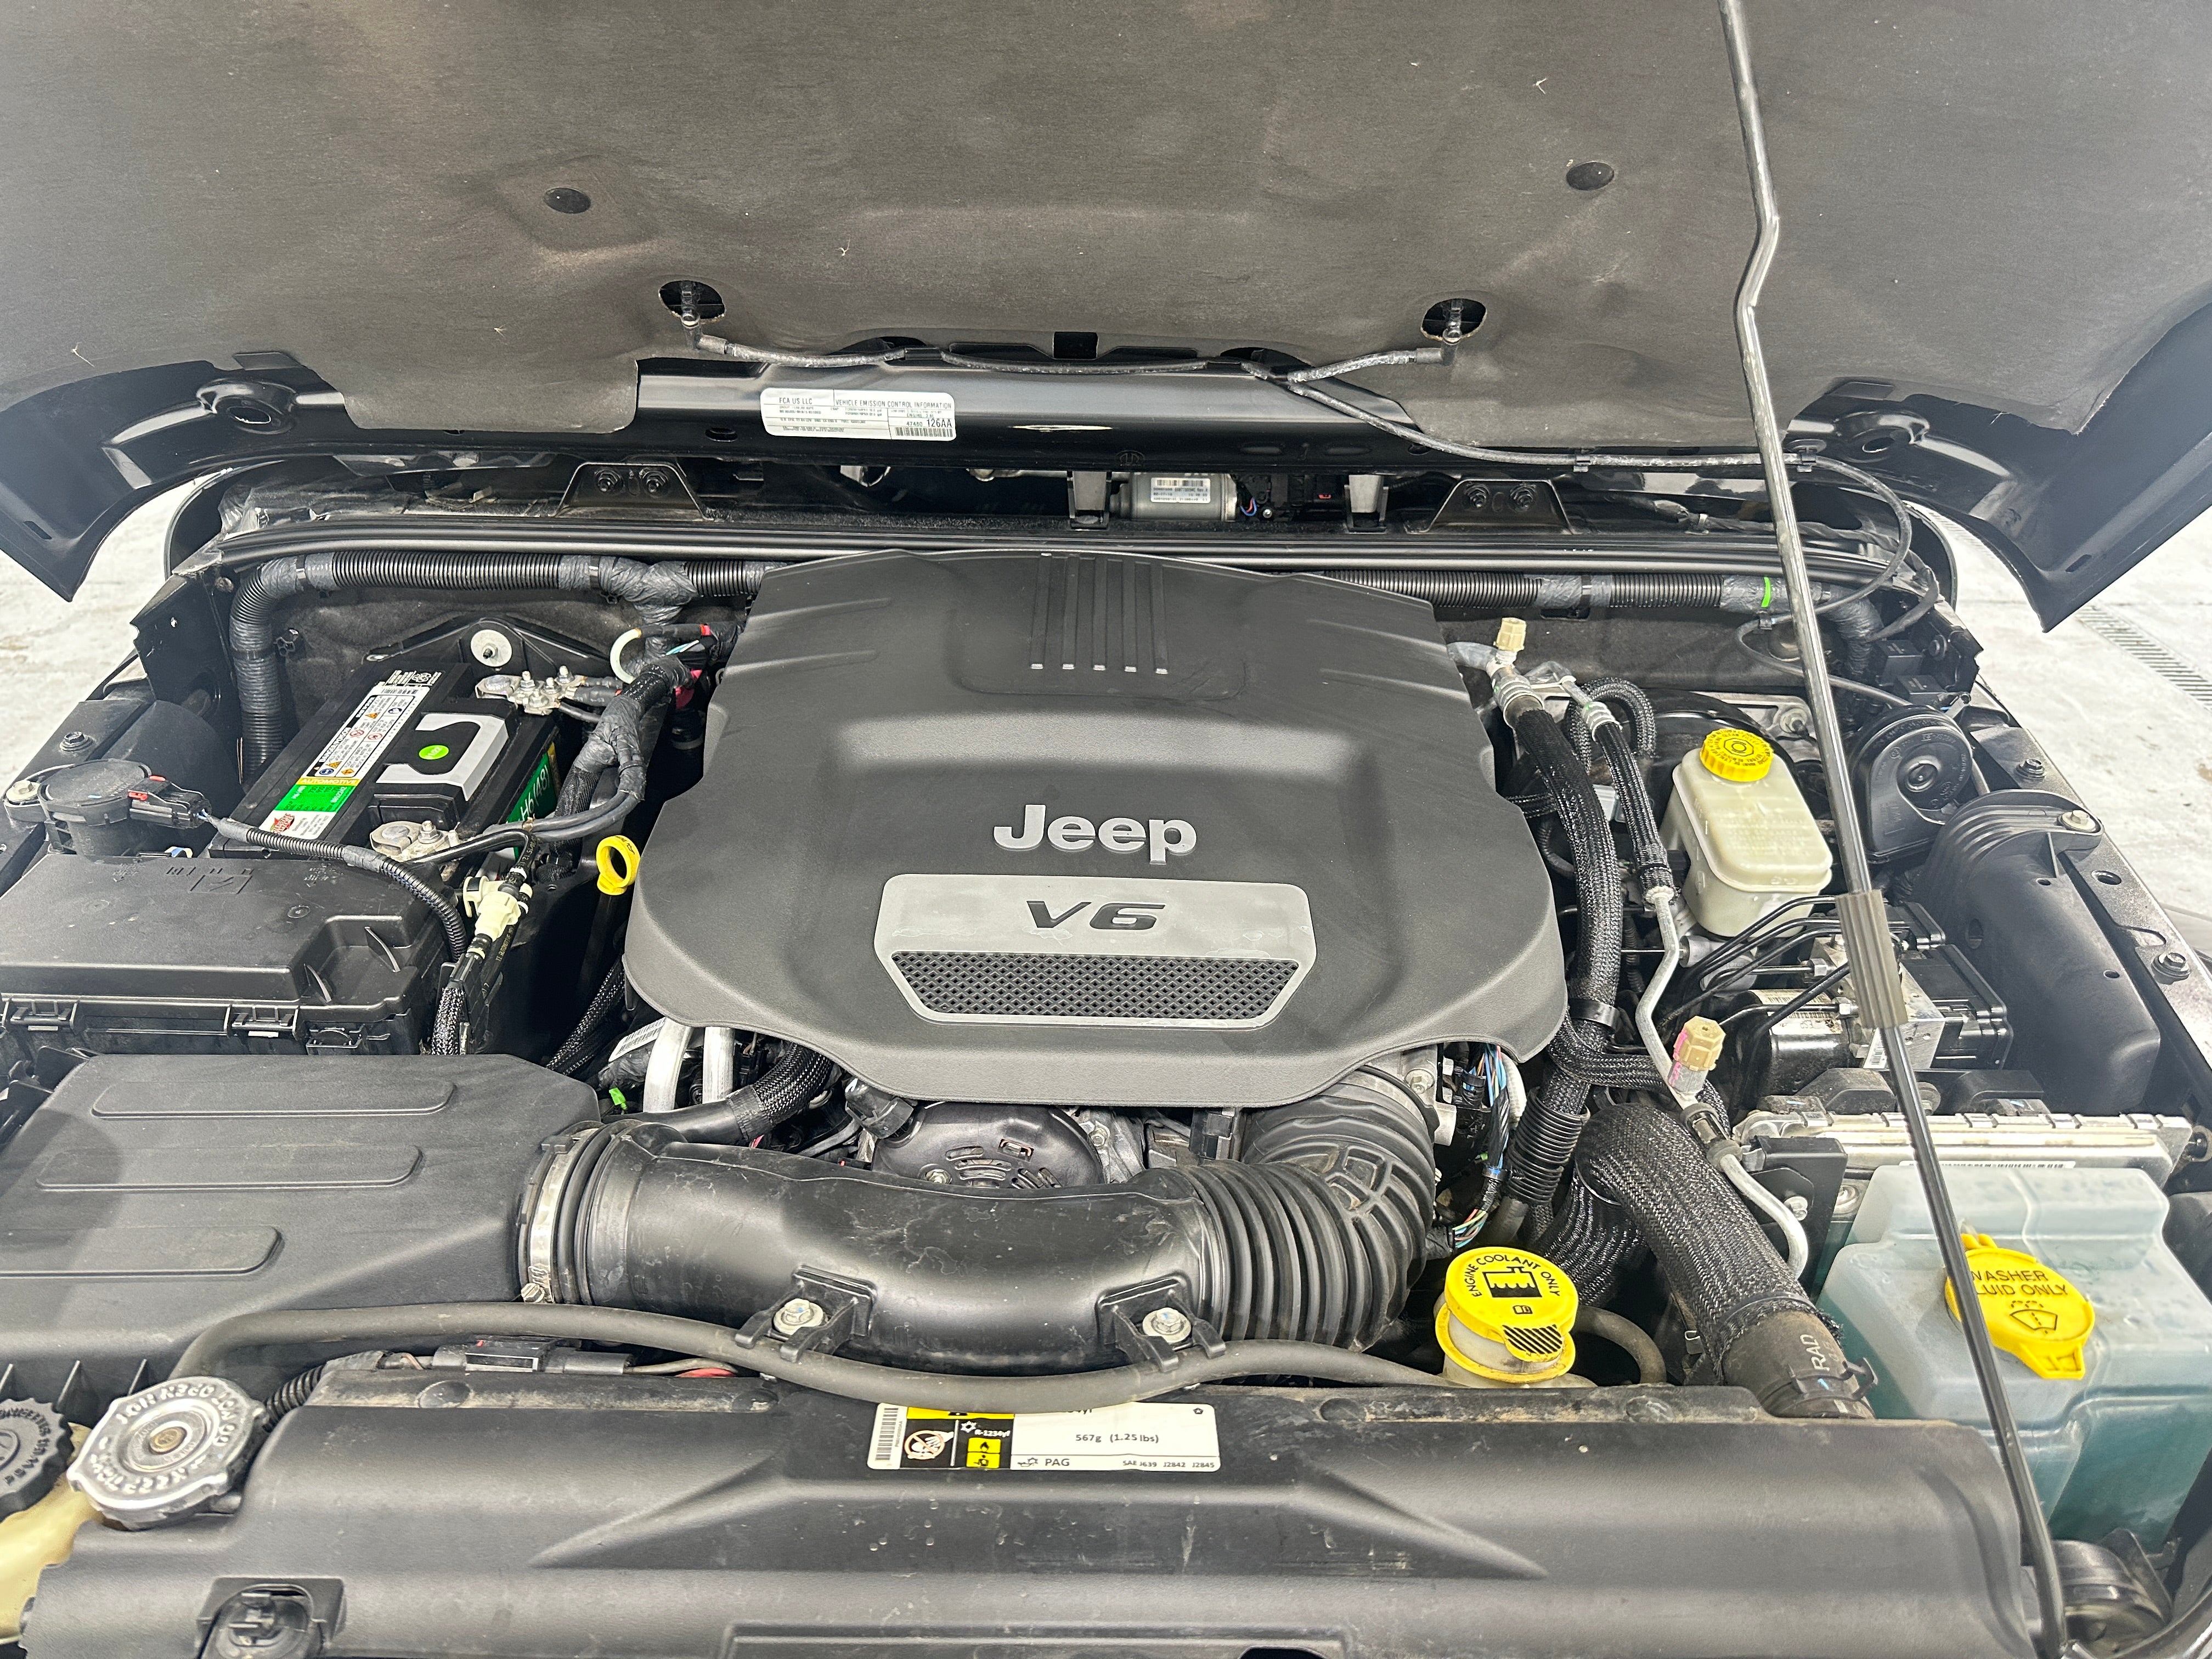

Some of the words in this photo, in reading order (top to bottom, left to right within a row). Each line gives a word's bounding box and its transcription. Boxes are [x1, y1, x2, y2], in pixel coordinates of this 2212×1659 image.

[927, 418, 952, 427] 126AA
[994, 804, 1197, 865] Jeep
[1026, 900, 1165, 930] V6
[1464, 1263, 1482, 1297] ENGINE
[1476, 1254, 1541, 1269] COOLANT
[1541, 1271, 1560, 1296] ONLY
[2021, 1284, 2068, 1295] ONLY
[1800, 1334, 1830, 1372] RAD
[160, 1384, 215, 1398] OPEN
[116, 1393, 156, 1424] HOT
[974, 1429, 1011, 1437] R-1234yf
[1075, 1434, 1102, 1443] 567g
[1109, 1434, 1137, 1443] (1.25
[1140, 1434, 1159, 1443] lbs)
[1045, 1458, 1070, 1466] PAG
